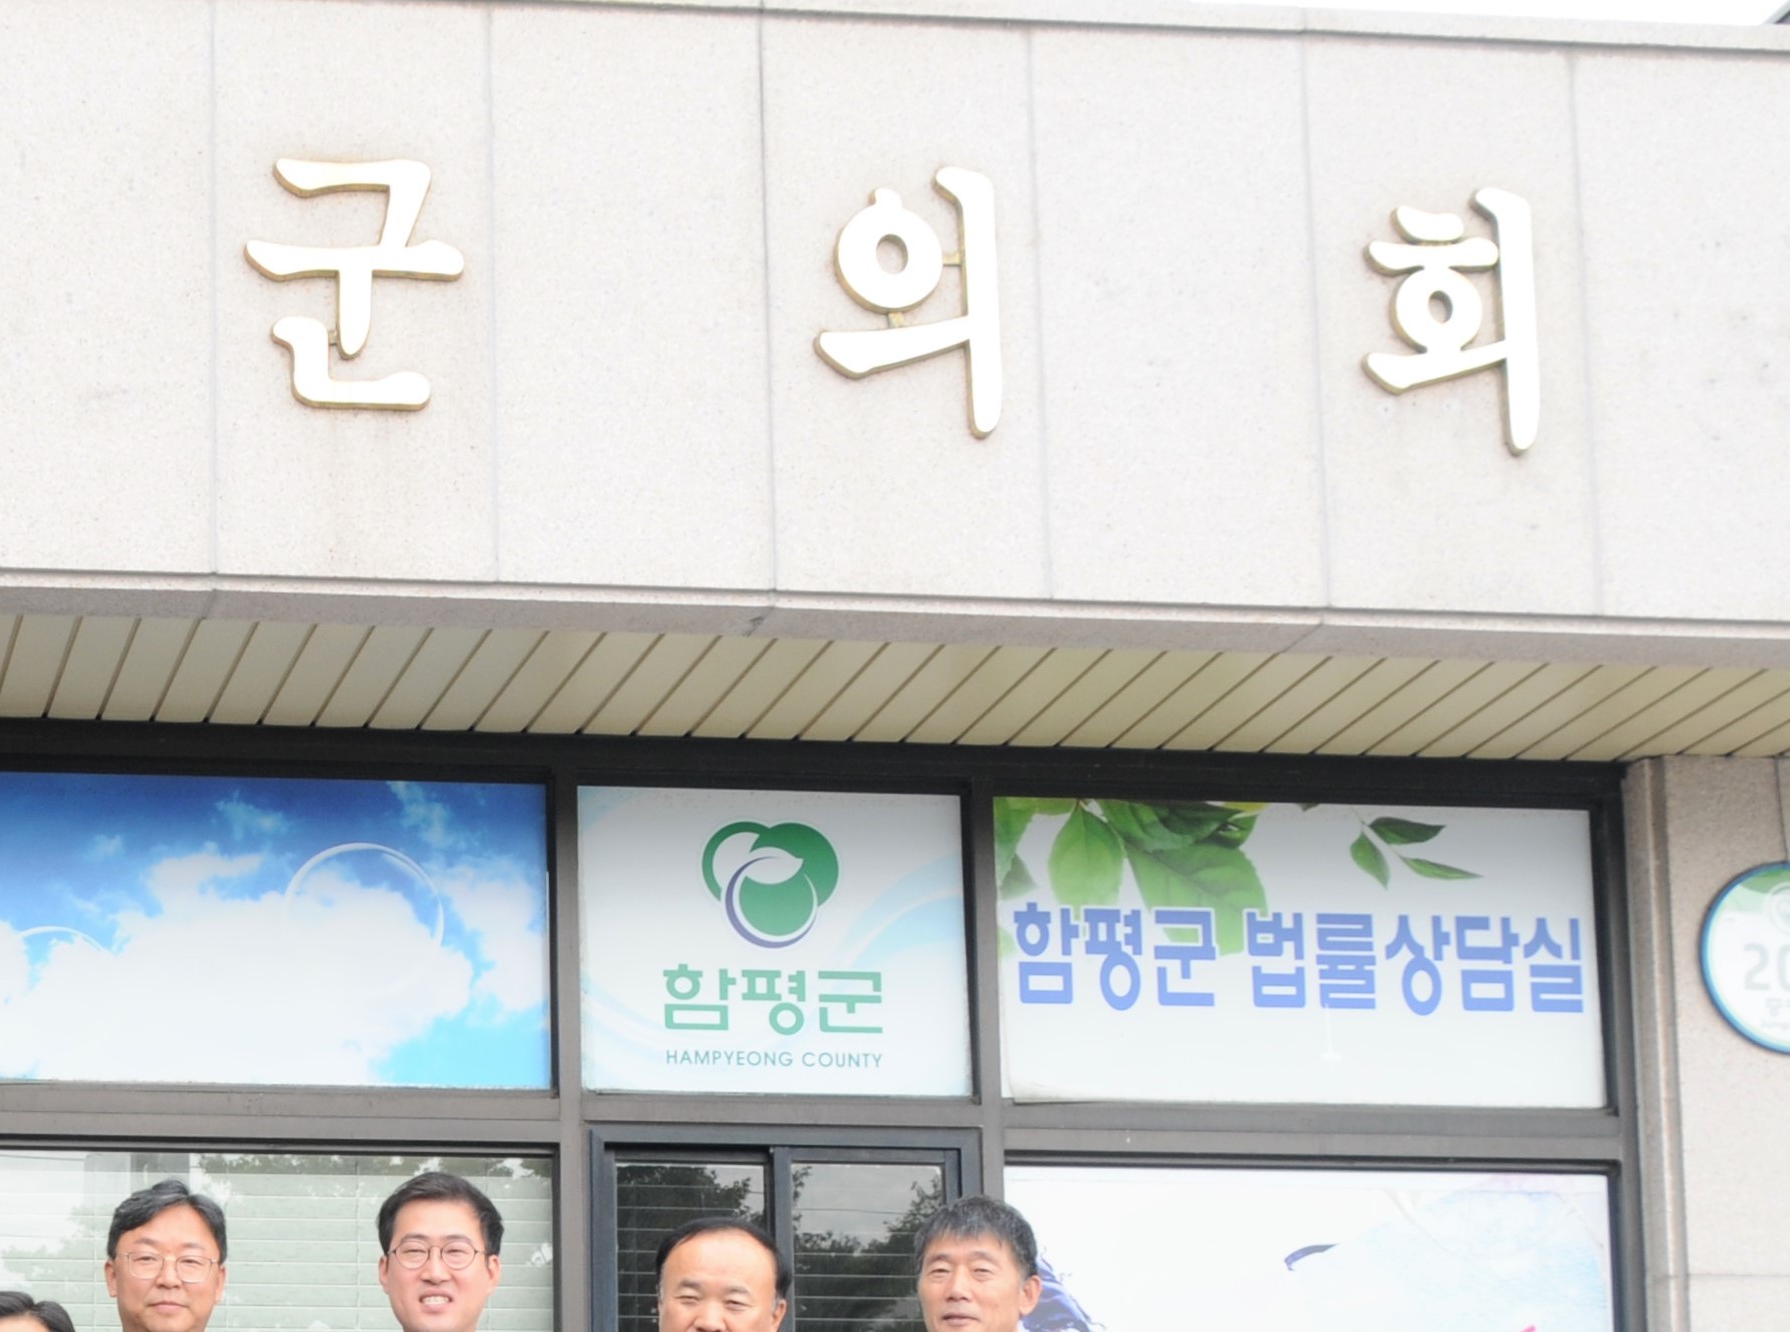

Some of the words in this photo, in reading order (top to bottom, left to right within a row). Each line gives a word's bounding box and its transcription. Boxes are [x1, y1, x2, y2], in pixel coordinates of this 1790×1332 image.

[1014, 902, 1217, 1011] 함평군
[1245, 909, 1585, 1016] 법률상담실
[663, 963, 883, 1036] 함평군
[666, 1049, 794, 1068] HAMPYEONG
[802, 1052, 883, 1068] COUNTY
